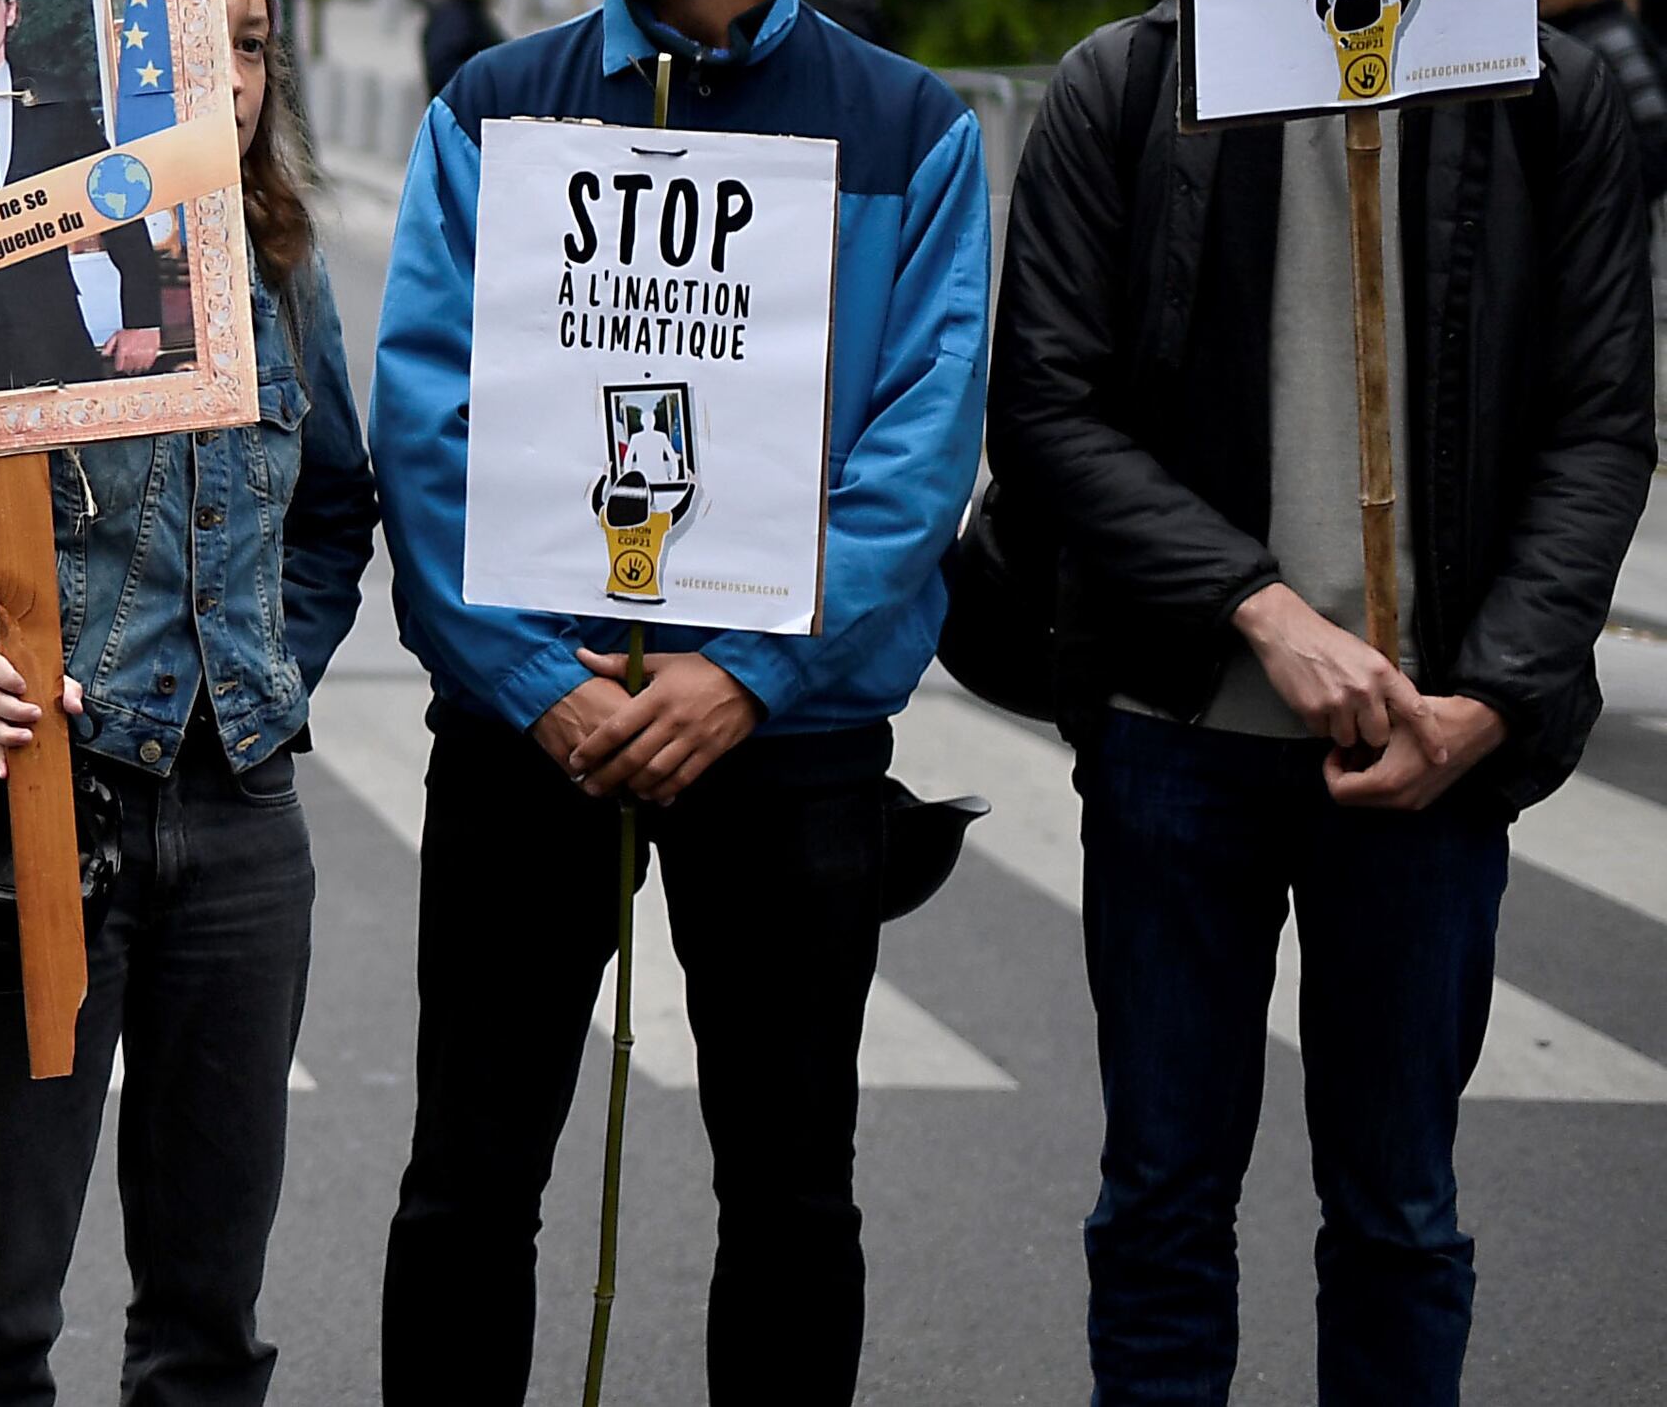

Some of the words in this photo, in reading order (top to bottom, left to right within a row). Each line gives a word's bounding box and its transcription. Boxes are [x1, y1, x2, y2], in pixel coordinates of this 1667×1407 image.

[23, 188, 48, 210] se
[58, 210, 84, 235] du
[563, 171, 754, 273] STOP
[558, 261, 574, 306] À
[589, 269, 750, 319] L'INACTION
[560, 311, 746, 361] CLIMATIQUE
[618, 536, 651, 547] COP21
